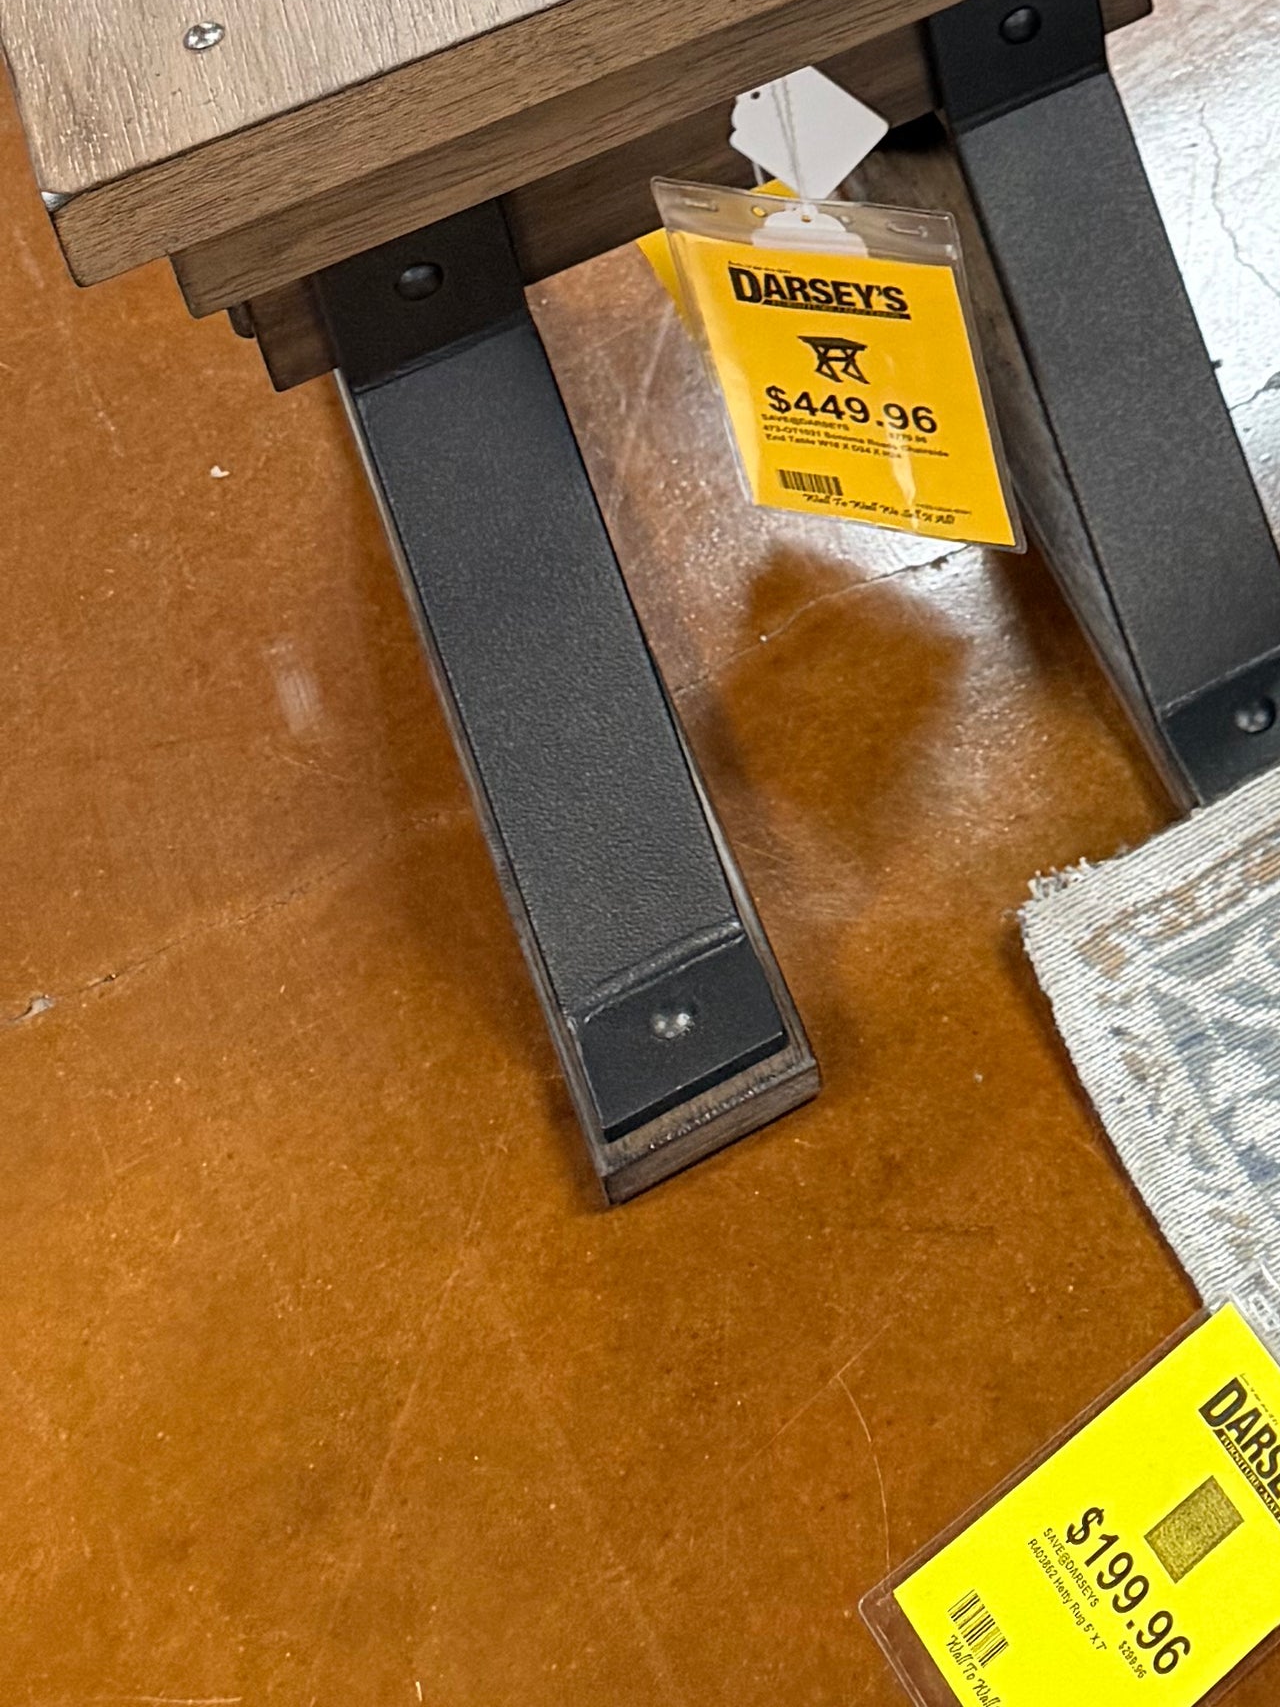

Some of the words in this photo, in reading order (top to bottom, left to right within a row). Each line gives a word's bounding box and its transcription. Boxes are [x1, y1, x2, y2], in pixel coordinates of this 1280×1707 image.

[729, 267, 907, 312] DARSEY'S
[765, 385, 937, 434] $449.96
[1042, 1527, 1100, 1607] SAVE@DARSEYS
[1065, 1506, 1189, 1674] $199.96
[1069, 1602, 1086, 1626] Rug
[1089, 1632, 1101, 1644] X
[946, 1635, 973, 1665] Wall
[963, 1662, 978, 1681] To
